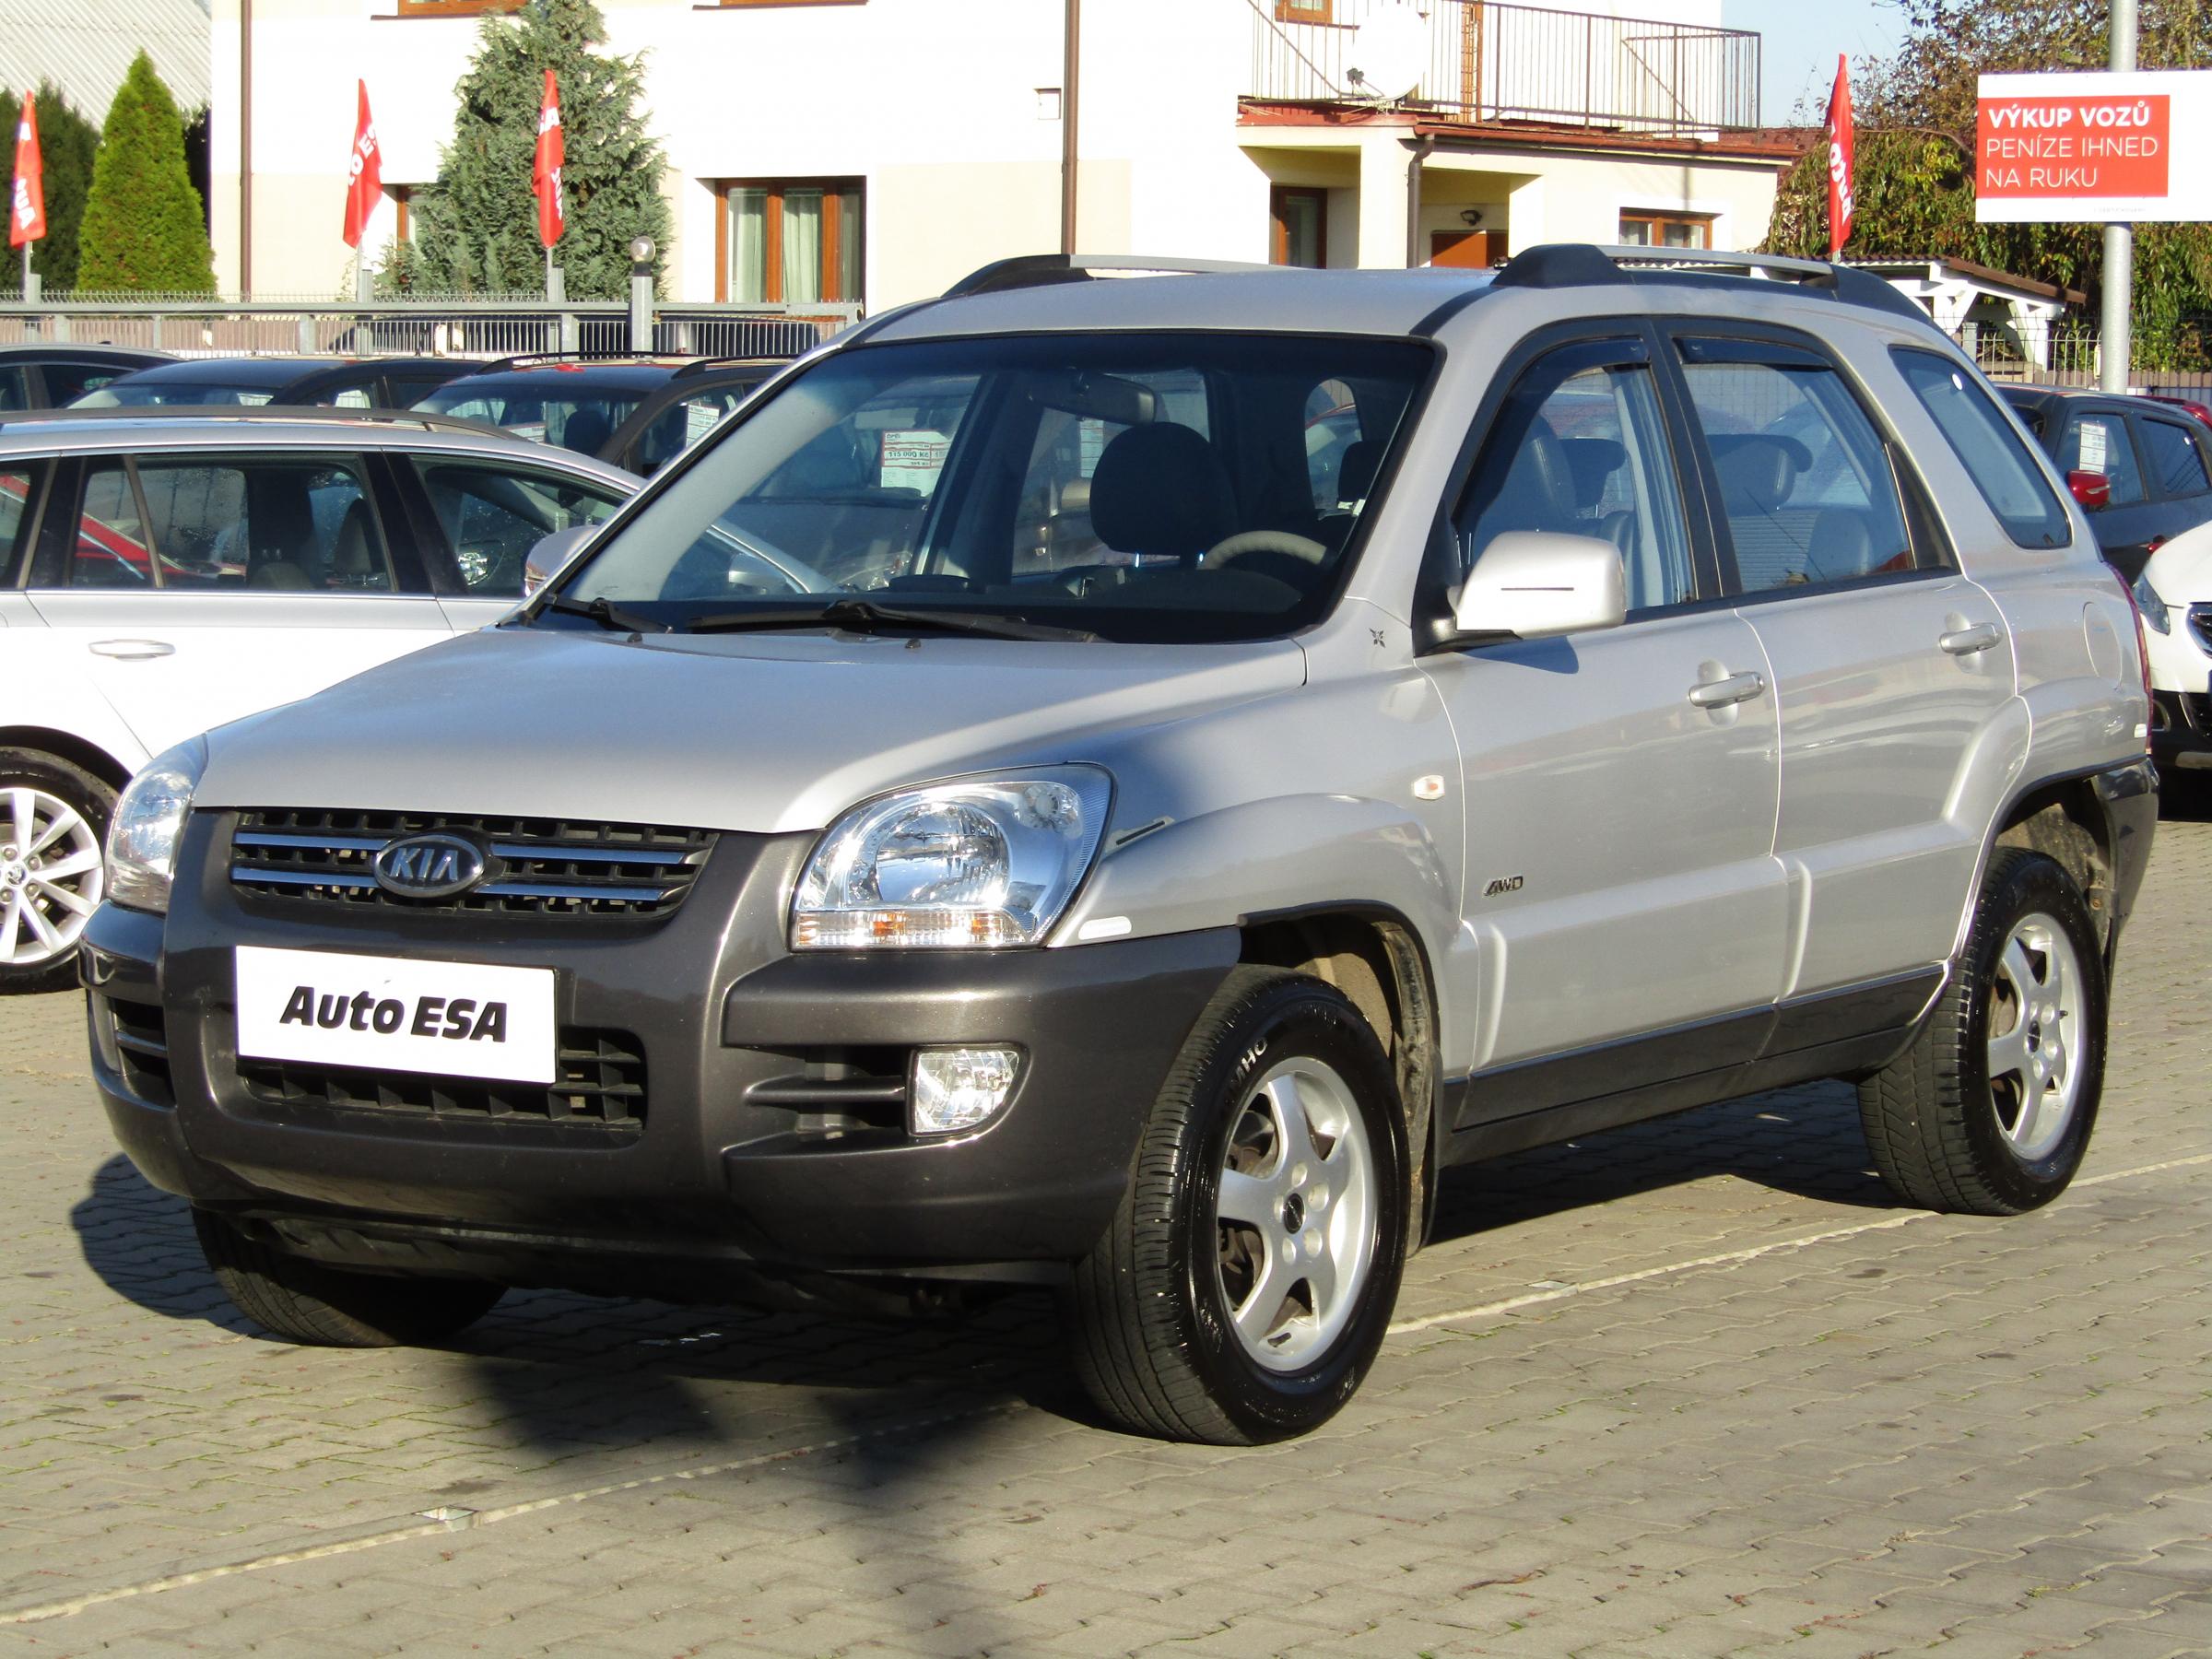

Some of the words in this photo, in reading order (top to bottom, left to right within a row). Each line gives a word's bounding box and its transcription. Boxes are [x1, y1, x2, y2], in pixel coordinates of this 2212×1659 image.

[1988, 103, 2072, 128] VÝKUP
[2079, 100, 2150, 127] VOZŮ
[1986, 134, 2073, 158] PENÍZE
[2081, 136, 2159, 158] IHNED
[1985, 169, 2021, 188] NA
[2030, 168, 2098, 188] RUKU
[389, 846, 459, 881] KIA
[279, 985, 406, 1034] Auto
[410, 996, 507, 1043] ESA
